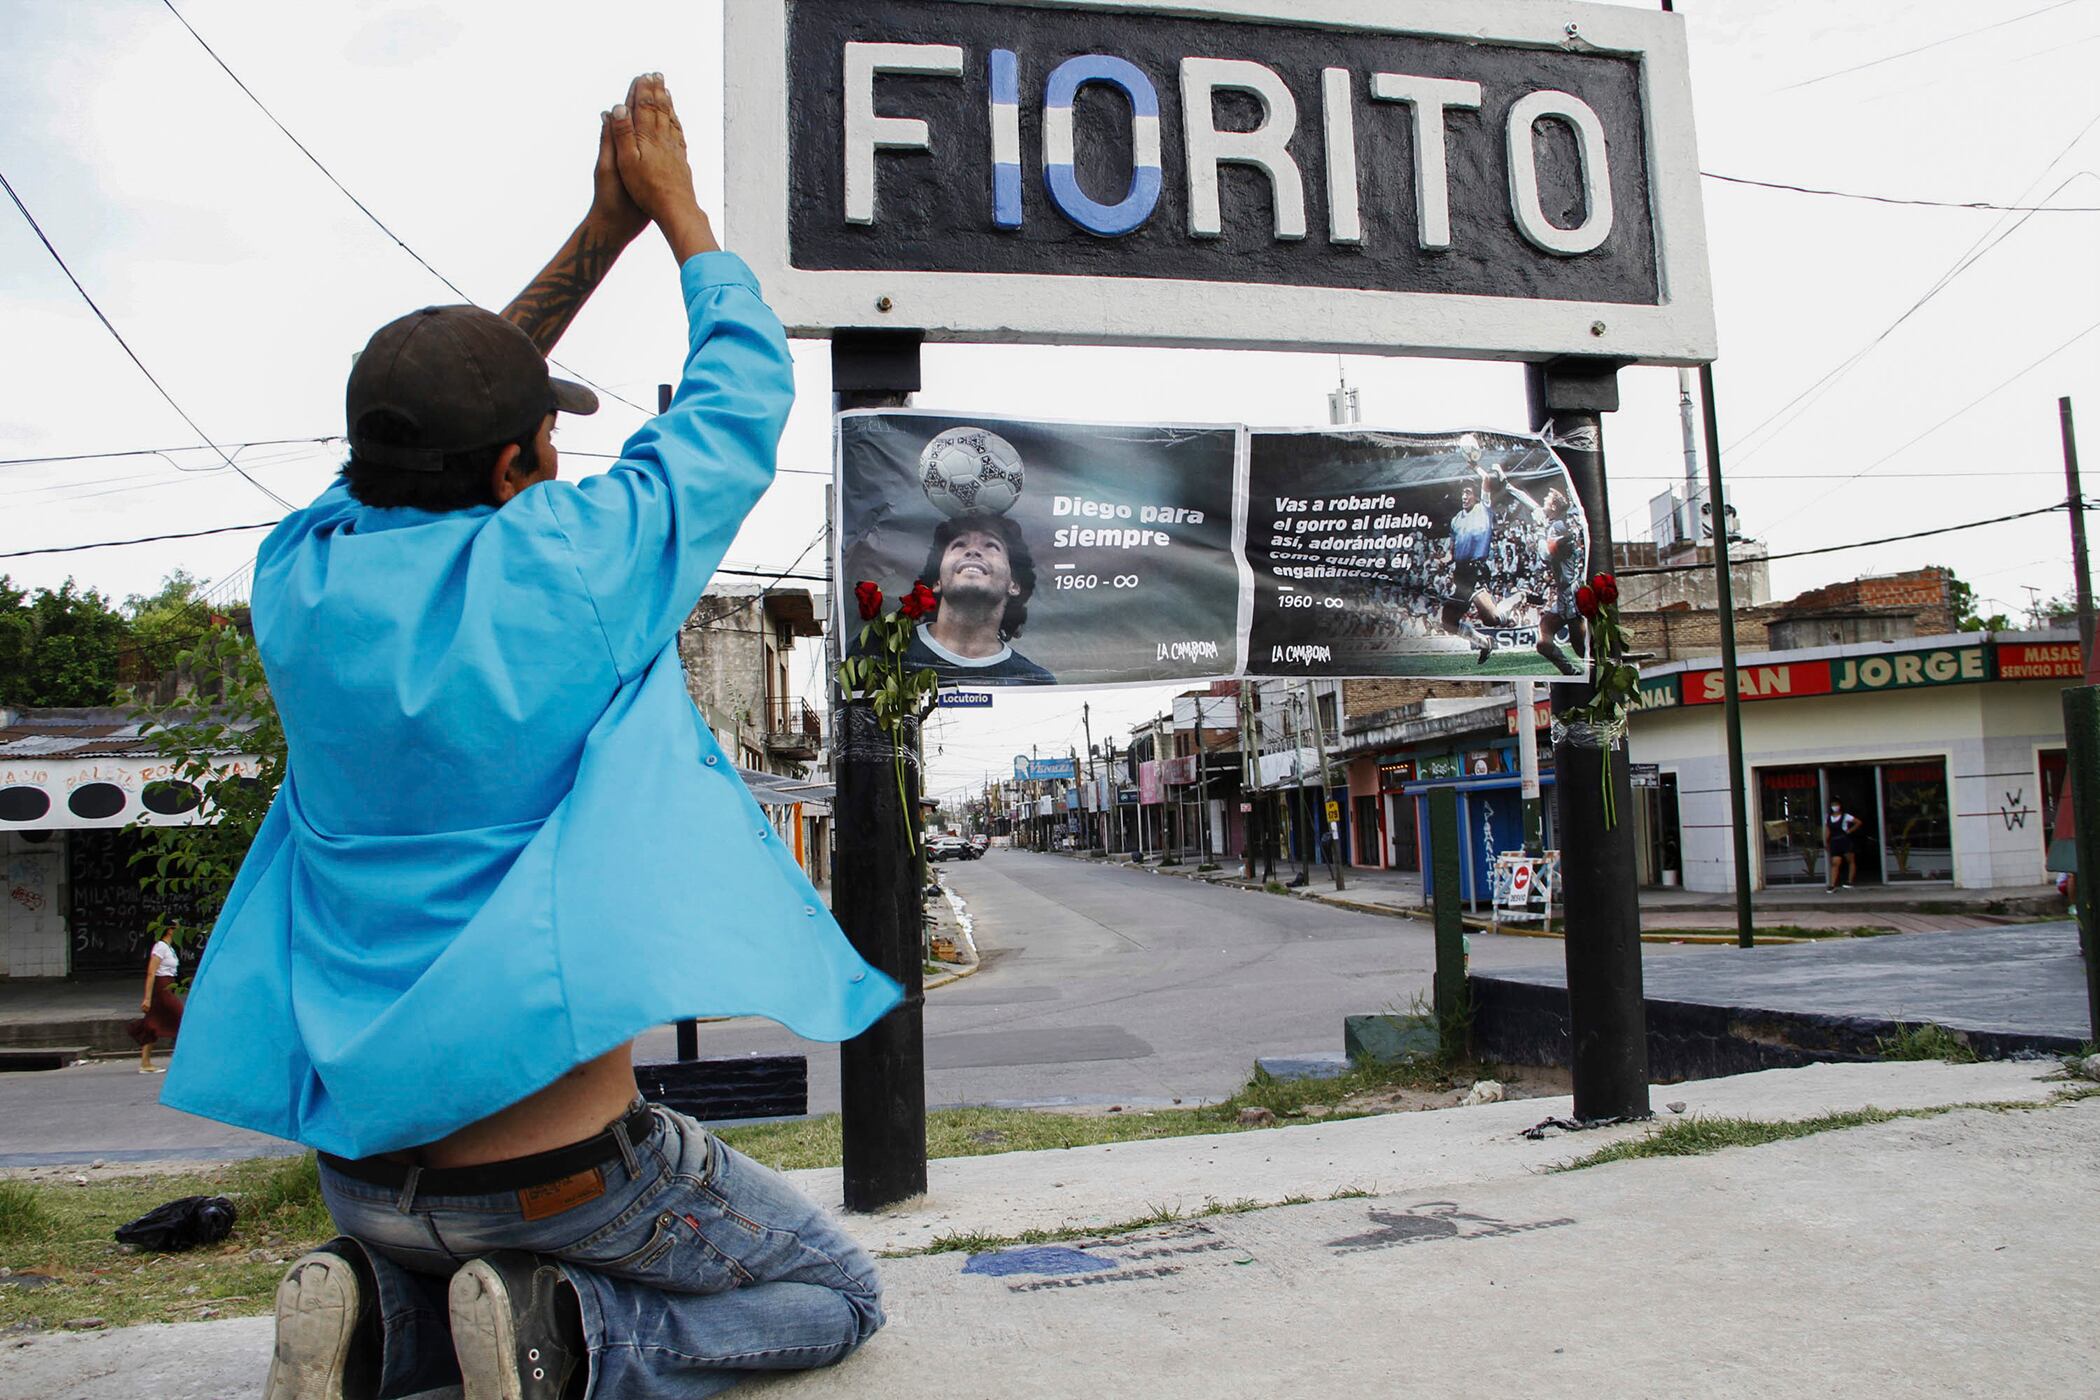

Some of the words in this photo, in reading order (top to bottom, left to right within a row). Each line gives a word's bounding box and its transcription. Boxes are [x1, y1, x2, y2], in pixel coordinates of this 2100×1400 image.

[842, 40, 1614, 257] FIORITO
[1053, 496, 1132, 519] Diego
[1140, 505, 1205, 524] para
[1275, 497, 1307, 512] Vas
[1312, 500, 1324, 511] a
[1328, 494, 1396, 511] robarle
[1273, 518, 1292, 531] el
[1295, 518, 1347, 534] gorro
[1351, 515, 1370, 530] al
[1373, 513, 1433, 529] diablo,
[1053, 525, 1170, 549] siempre
[1271, 535, 1303, 550] así,
[1309, 534, 1414, 550] adorándolo
[1269, 551, 1320, 562] como
[1325, 555, 1386, 568] quiere
[1391, 553, 1412, 571] él,
[1054, 575, 1098, 589] 1960
[1272, 565, 1393, 581] engañándolo.
[1278, 596, 1312, 608] 1960
[1156, 643, 1169, 661] LA
[1271, 645, 1284, 663] LA
[2024, 647, 2081, 663] MASAS
[1703, 666, 1792, 700] SAN
[1838, 649, 1985, 690] JORGE
[2001, 664, 2052, 679] SERVICIO
[2055, 664, 2070, 677] DE
[943, 694, 989, 703] Locutorio
